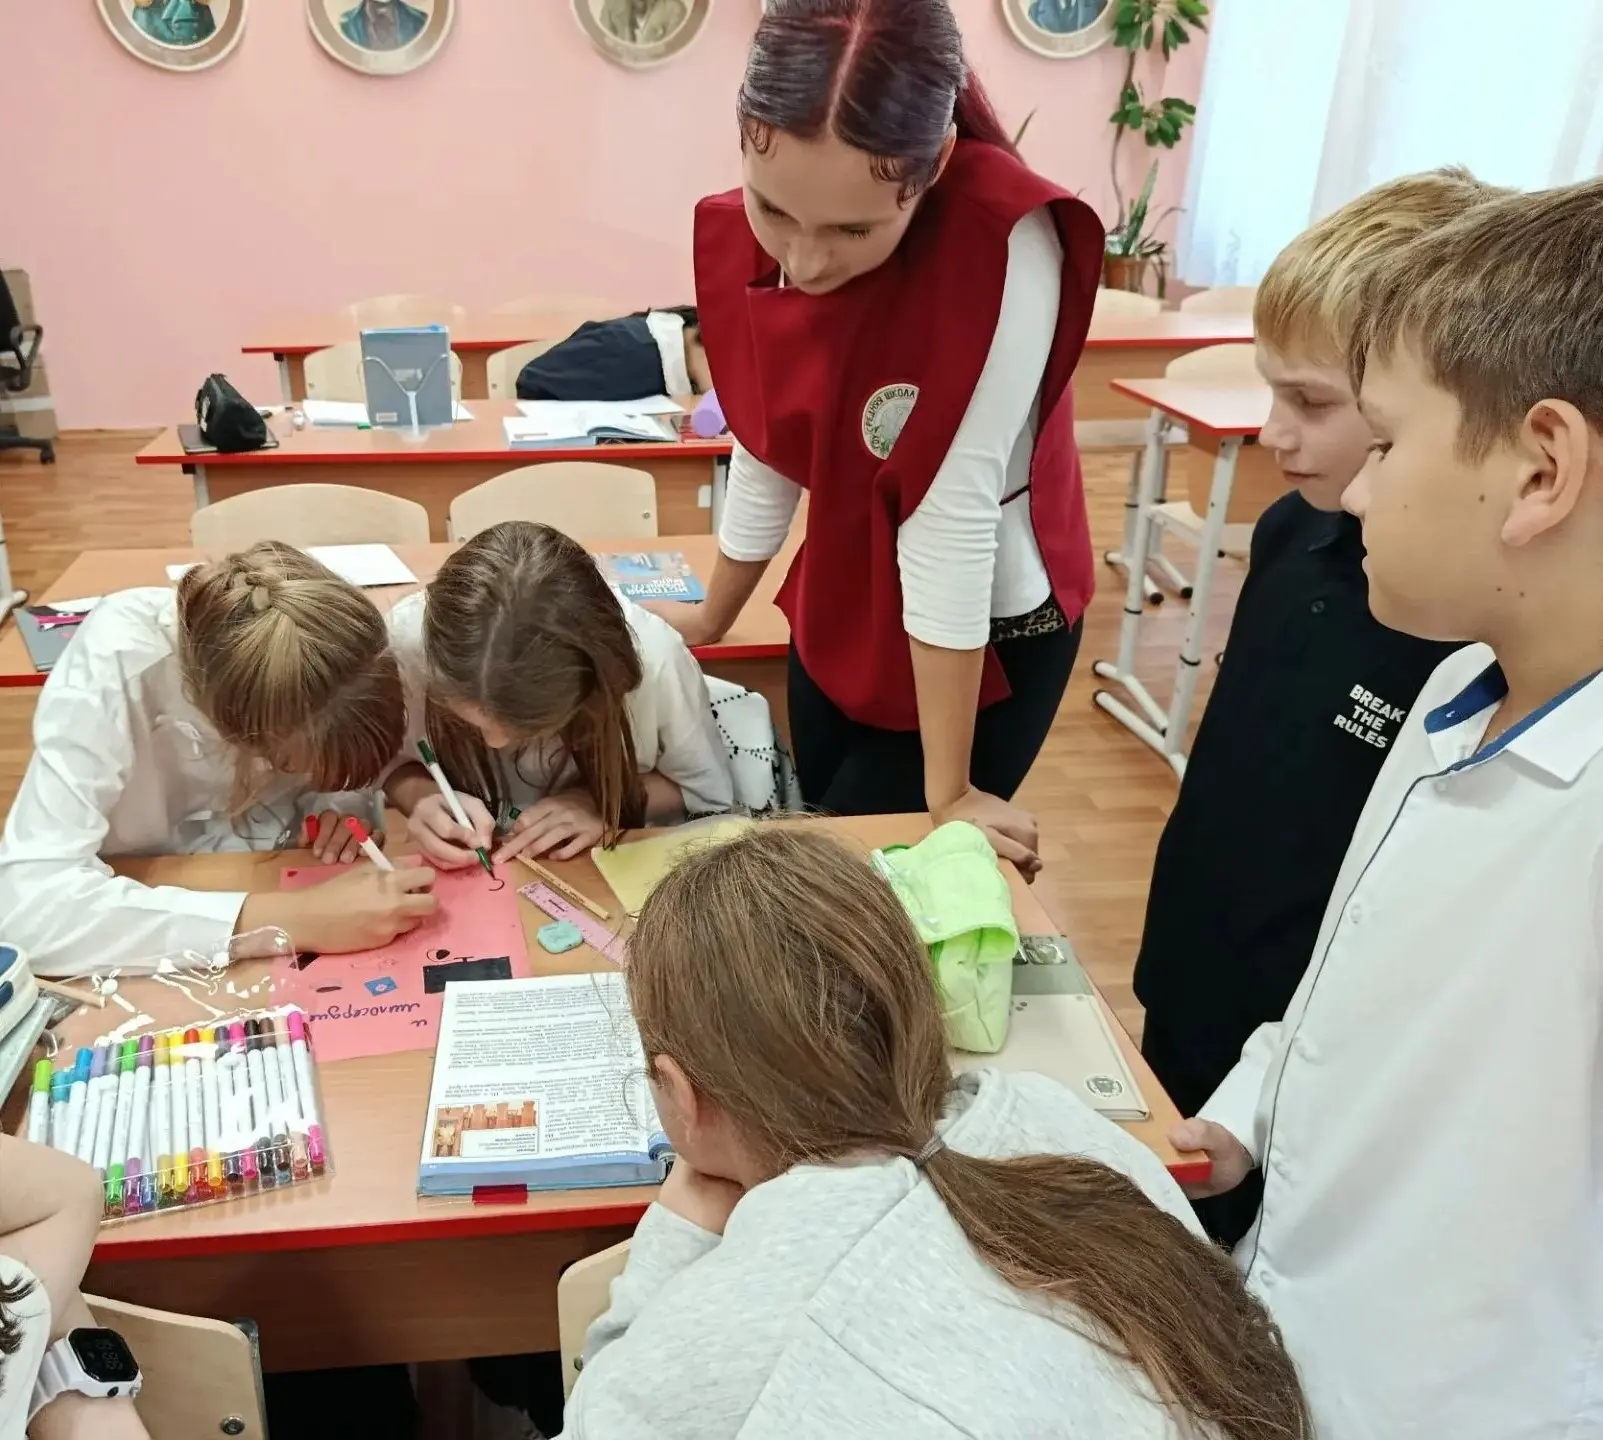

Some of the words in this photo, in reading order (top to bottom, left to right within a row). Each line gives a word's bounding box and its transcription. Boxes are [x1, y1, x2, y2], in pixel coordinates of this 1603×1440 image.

[884, 388, 916, 400] ШКОЛА
[1349, 683, 1406, 723] BREAK
[1333, 714, 1388, 748] RULES
[1352, 704, 1386, 731] THE
[309, 1002, 420, 1022] милосердие
